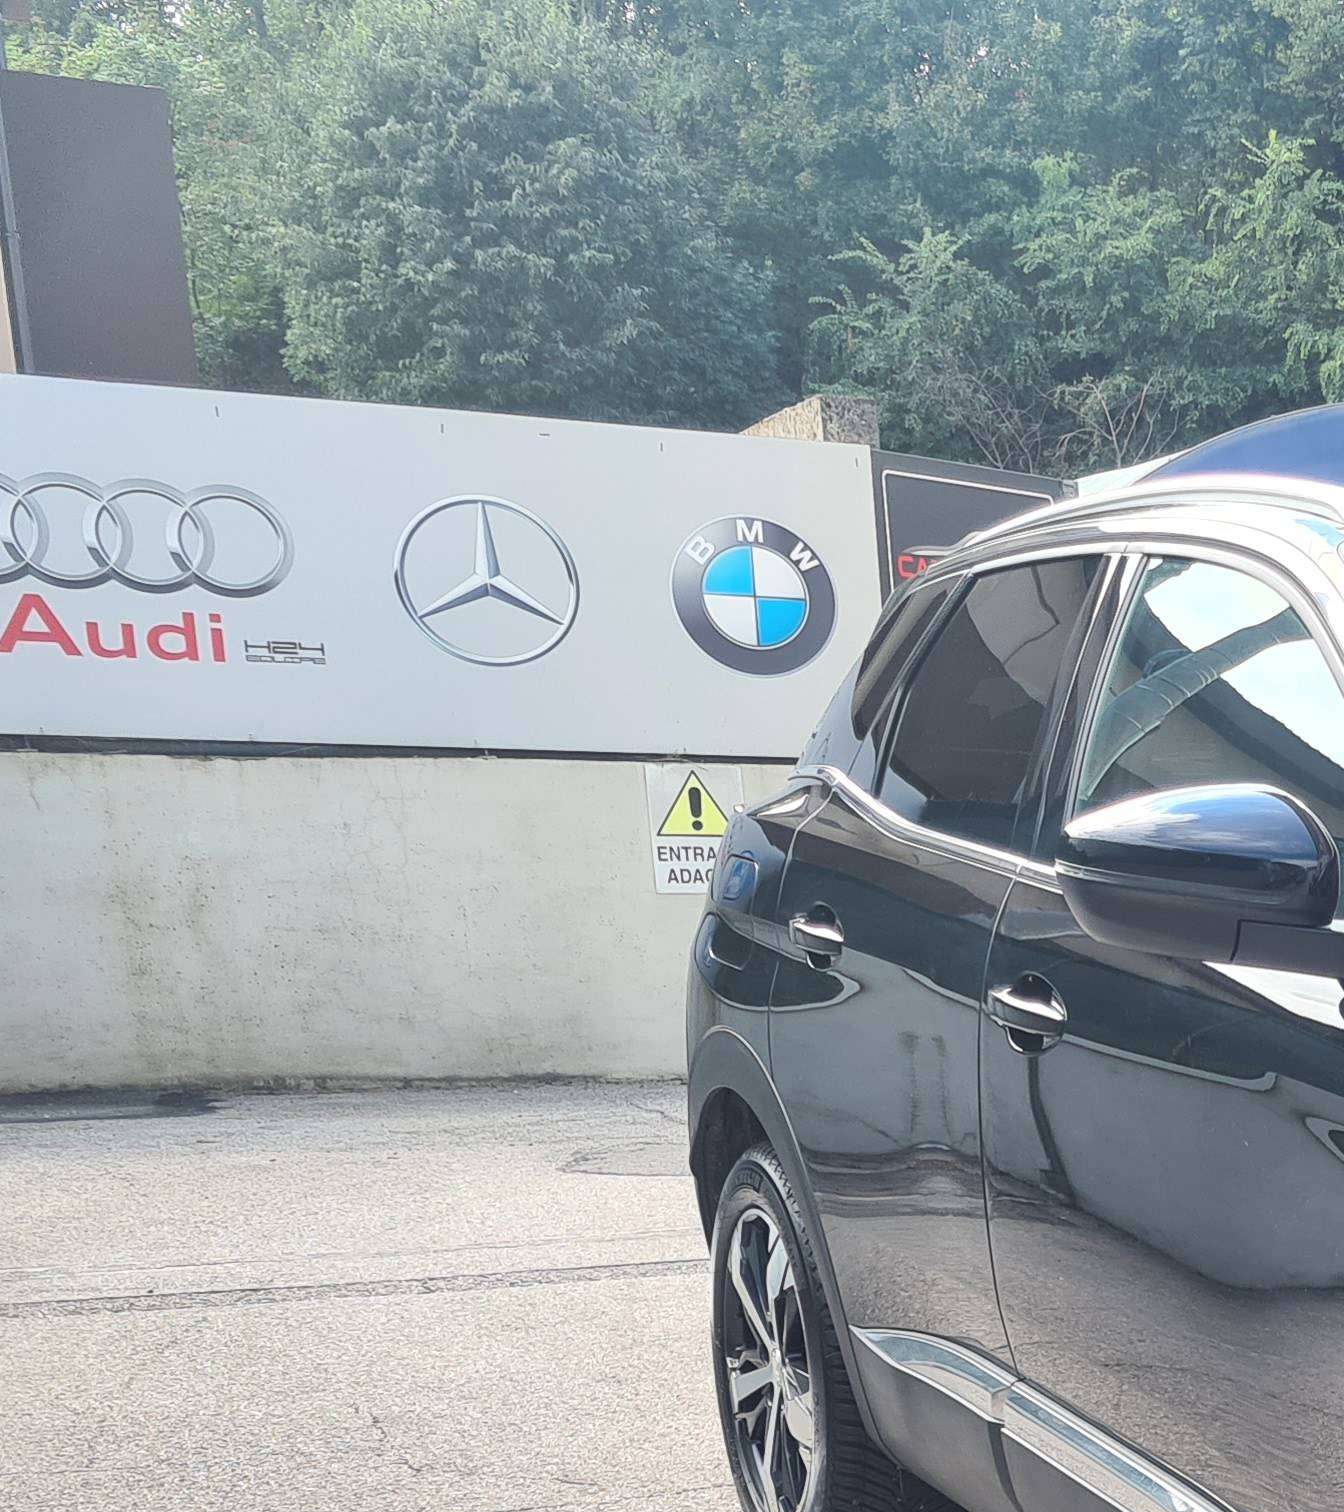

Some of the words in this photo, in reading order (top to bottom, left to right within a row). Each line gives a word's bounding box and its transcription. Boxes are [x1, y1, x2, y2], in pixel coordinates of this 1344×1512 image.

[683, 518, 821, 573] BMW
[0, 593, 226, 662] Audi
[243, 640, 326, 657] H24
